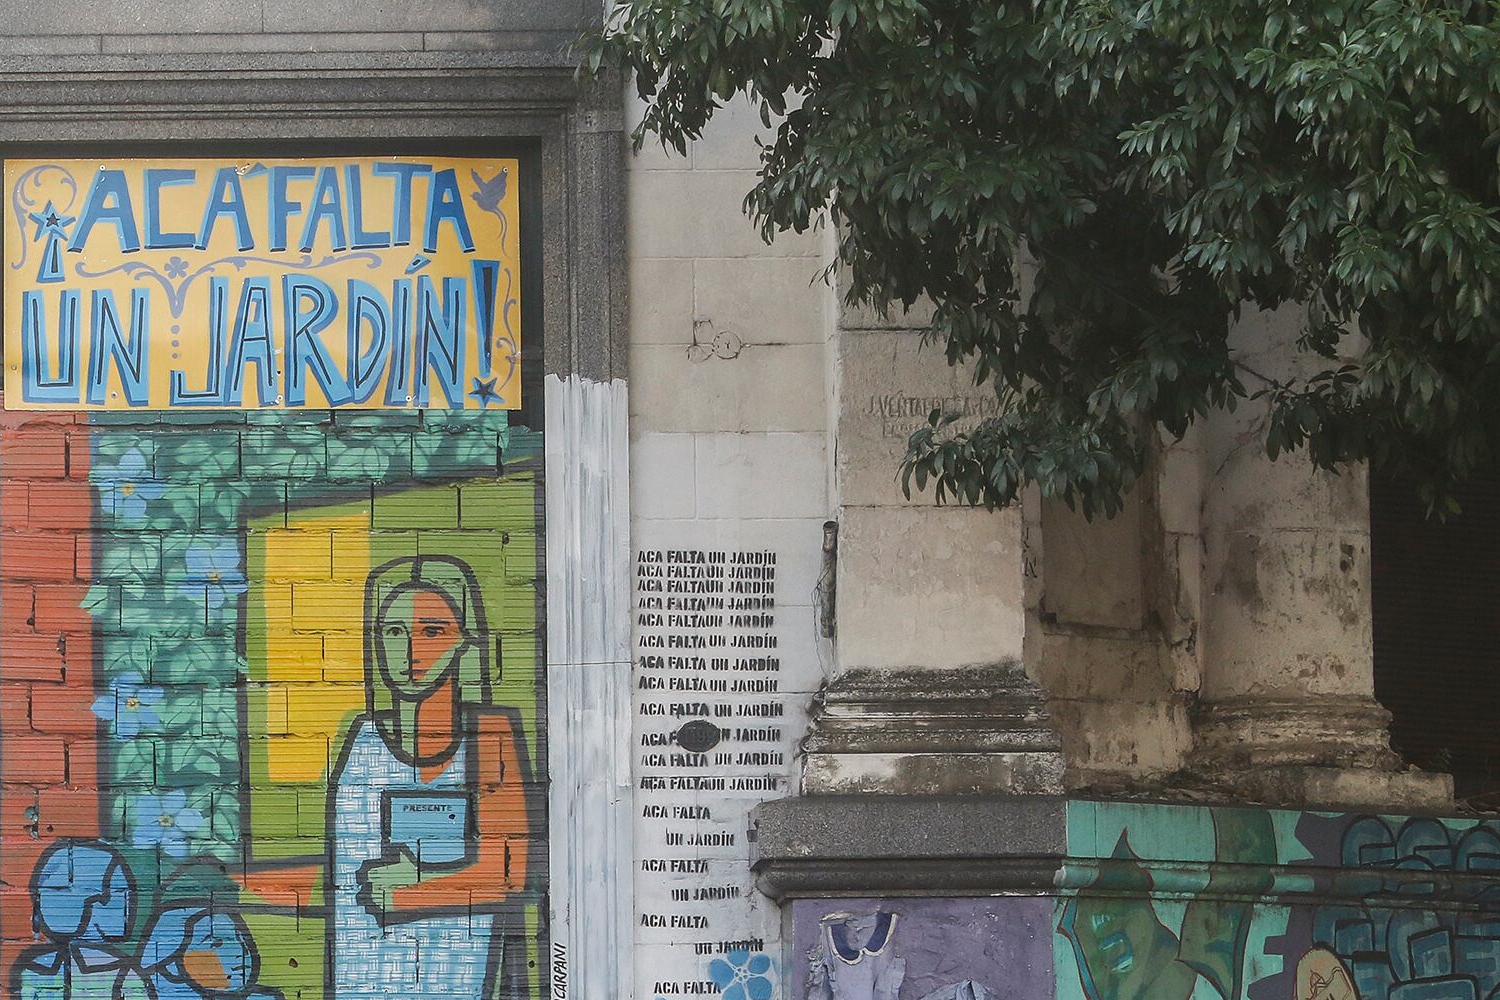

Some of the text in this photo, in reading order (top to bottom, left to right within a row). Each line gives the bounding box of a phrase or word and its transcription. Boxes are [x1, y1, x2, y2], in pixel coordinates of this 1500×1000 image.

[268, 162, 476, 254] FALTA
[21, 254, 500, 408] UN JARDÍN!
[638, 551, 662, 562] ACA
[667, 551, 705, 563] FALTA
[709, 552, 725, 563] UN
[640, 635, 664, 647] ACA
[669, 635, 706, 648] FALTA
[709, 635, 725, 647] UN
[639, 656, 664, 668] ACA
[668, 657, 706, 670] FALTA
[712, 659, 728, 670] UN
[640, 703, 665, 715] ACA
[670, 703, 709, 717] FALTA
[715, 705, 731, 717] UN
[642, 754, 666, 766] ACA
[670, 753, 708, 767] FALTA
[715, 753, 731, 765] UN
[403, 804, 452, 812] PRESENTE
[643, 805, 710, 819] ACA FALTA
[666, 833, 683, 845] UN
[642, 859, 708, 873] ACA FALTA
[672, 889, 688, 901] UN
